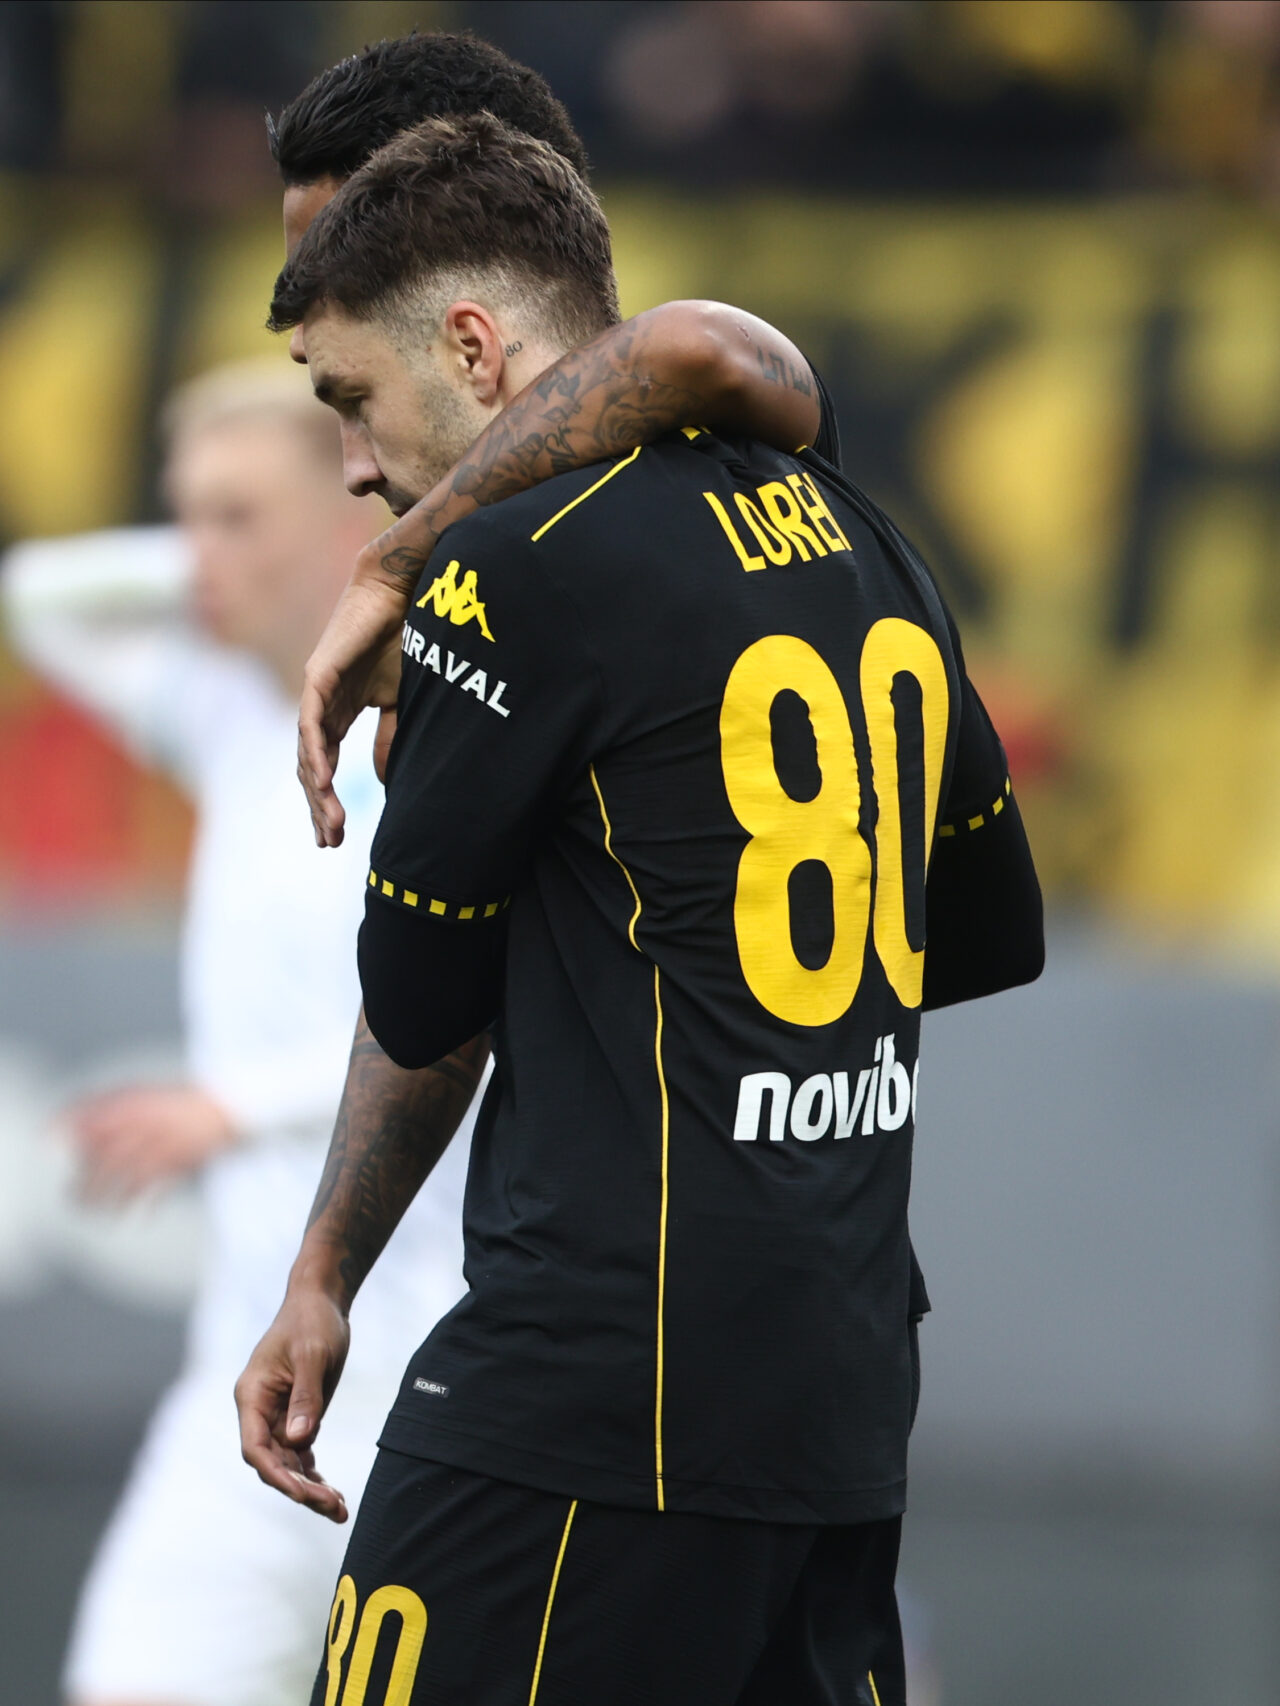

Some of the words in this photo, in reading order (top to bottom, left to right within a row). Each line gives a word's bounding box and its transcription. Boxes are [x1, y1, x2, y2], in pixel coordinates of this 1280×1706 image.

[505, 340, 522, 357] 80
[720, 617, 948, 1026] 80
[733, 1033, 920, 1142] novib
